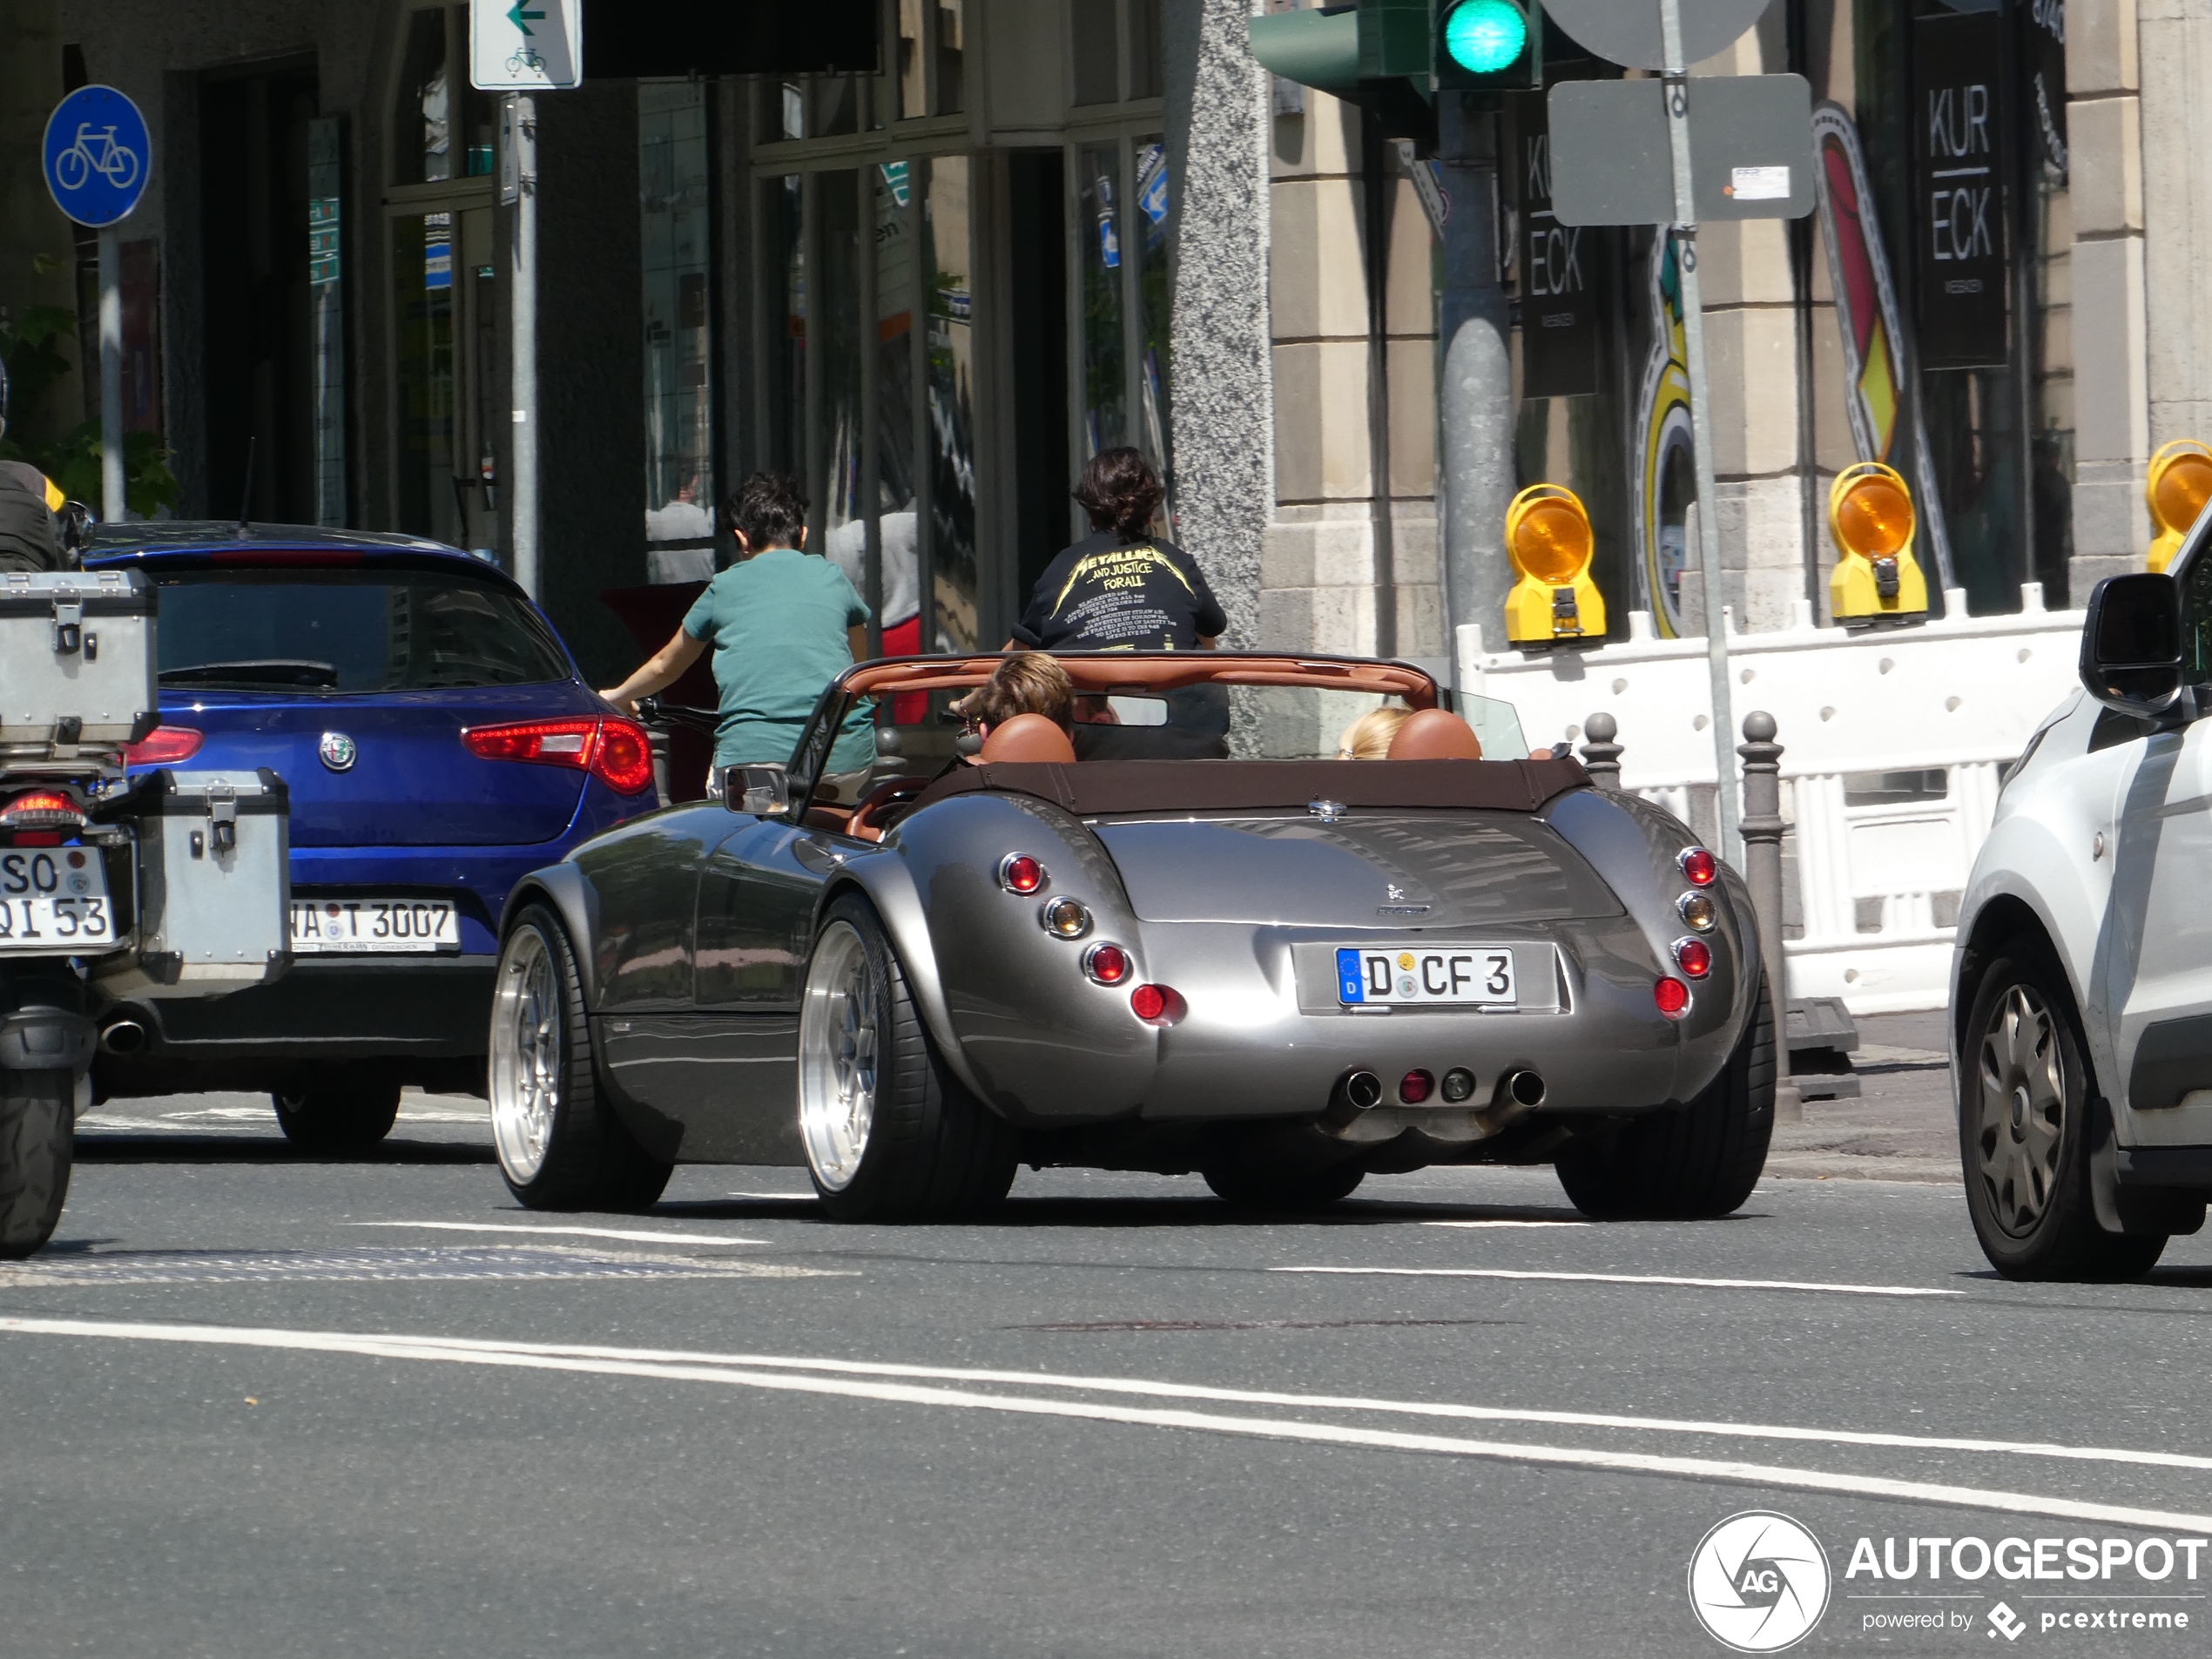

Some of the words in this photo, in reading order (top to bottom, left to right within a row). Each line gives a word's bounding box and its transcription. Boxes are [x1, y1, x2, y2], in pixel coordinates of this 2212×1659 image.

[1929, 84, 1990, 157] KUR
[1931, 186, 1993, 260] ECK
[1530, 226, 1583, 295] ECK
[1109, 561, 1153, 576] JUSTICE
[2, 853, 57, 894] SO
[51, 898, 106, 936] 53
[343, 903, 361, 936] T
[371, 903, 448, 938] 3007
[1345, 982, 1357, 994] D
[1366, 955, 1392, 995] D
[1421, 955, 1473, 995] CF
[1487, 955, 1509, 995] 3
